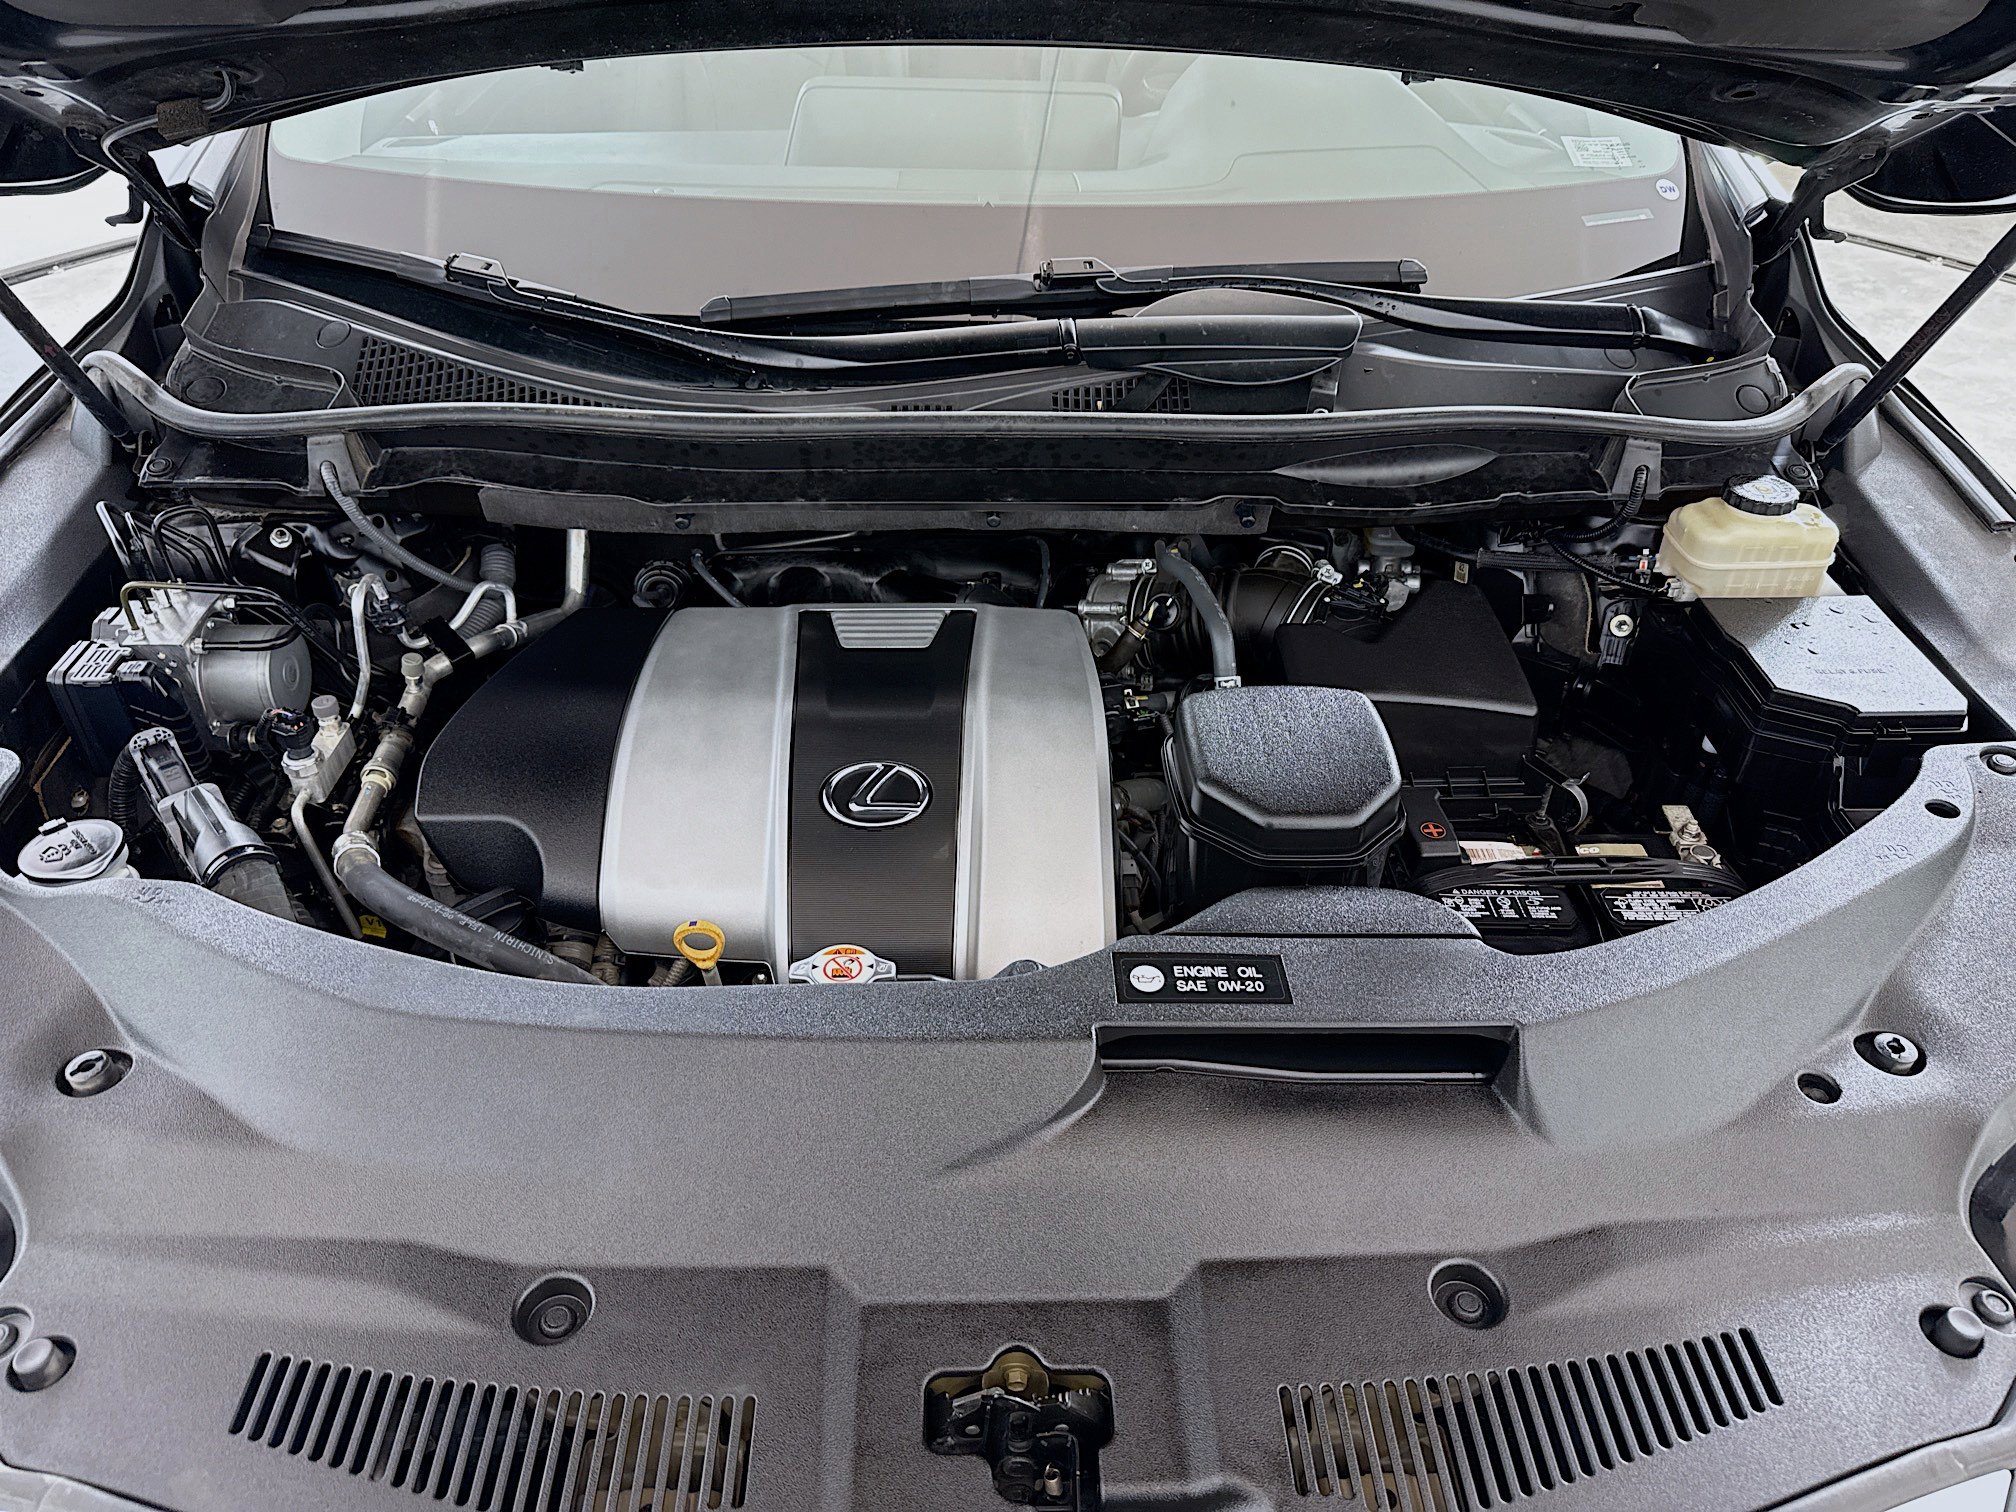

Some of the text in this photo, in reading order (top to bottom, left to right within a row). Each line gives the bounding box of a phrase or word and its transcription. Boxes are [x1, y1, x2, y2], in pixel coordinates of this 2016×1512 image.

[1506, 889, 1541, 897] POISON
[1173, 965, 1263, 979] ENGINE OIL
[1176, 980, 1265, 993] SAE 0W-20
